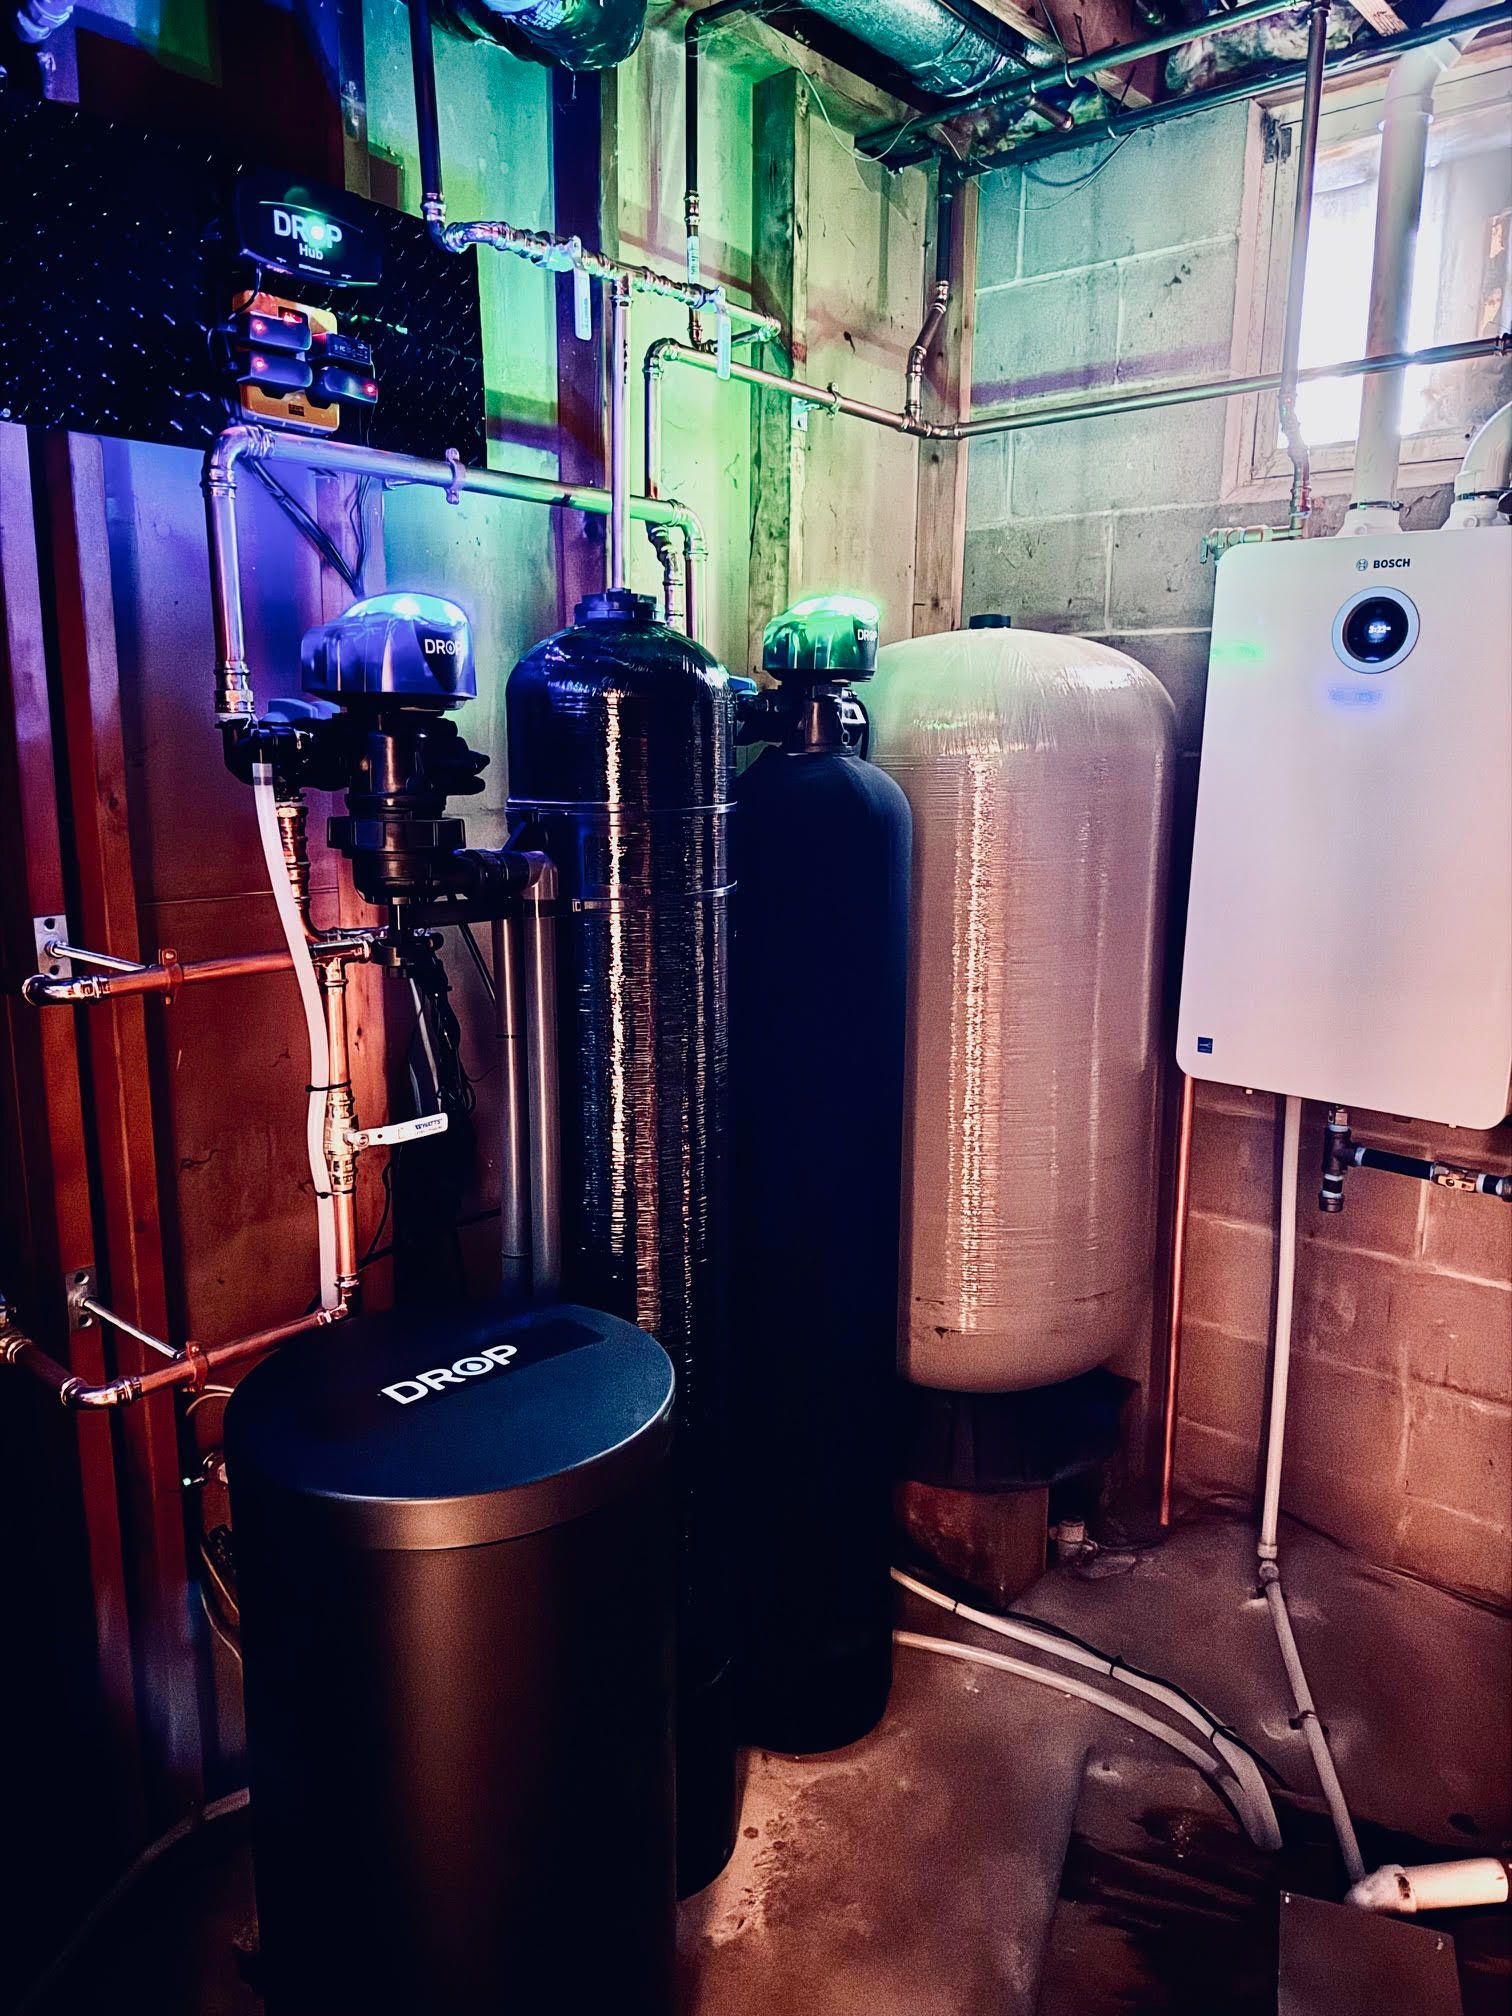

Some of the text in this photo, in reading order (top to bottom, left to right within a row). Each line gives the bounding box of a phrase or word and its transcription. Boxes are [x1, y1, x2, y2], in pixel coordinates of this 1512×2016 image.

[273, 209, 342, 248] DROP
[299, 243, 323, 260] Hub
[1373, 558, 1411, 569] BOSCH
[857, 629, 878, 642] DROP
[424, 638, 463, 656] DROP
[381, 1344, 518, 1405] DROP
